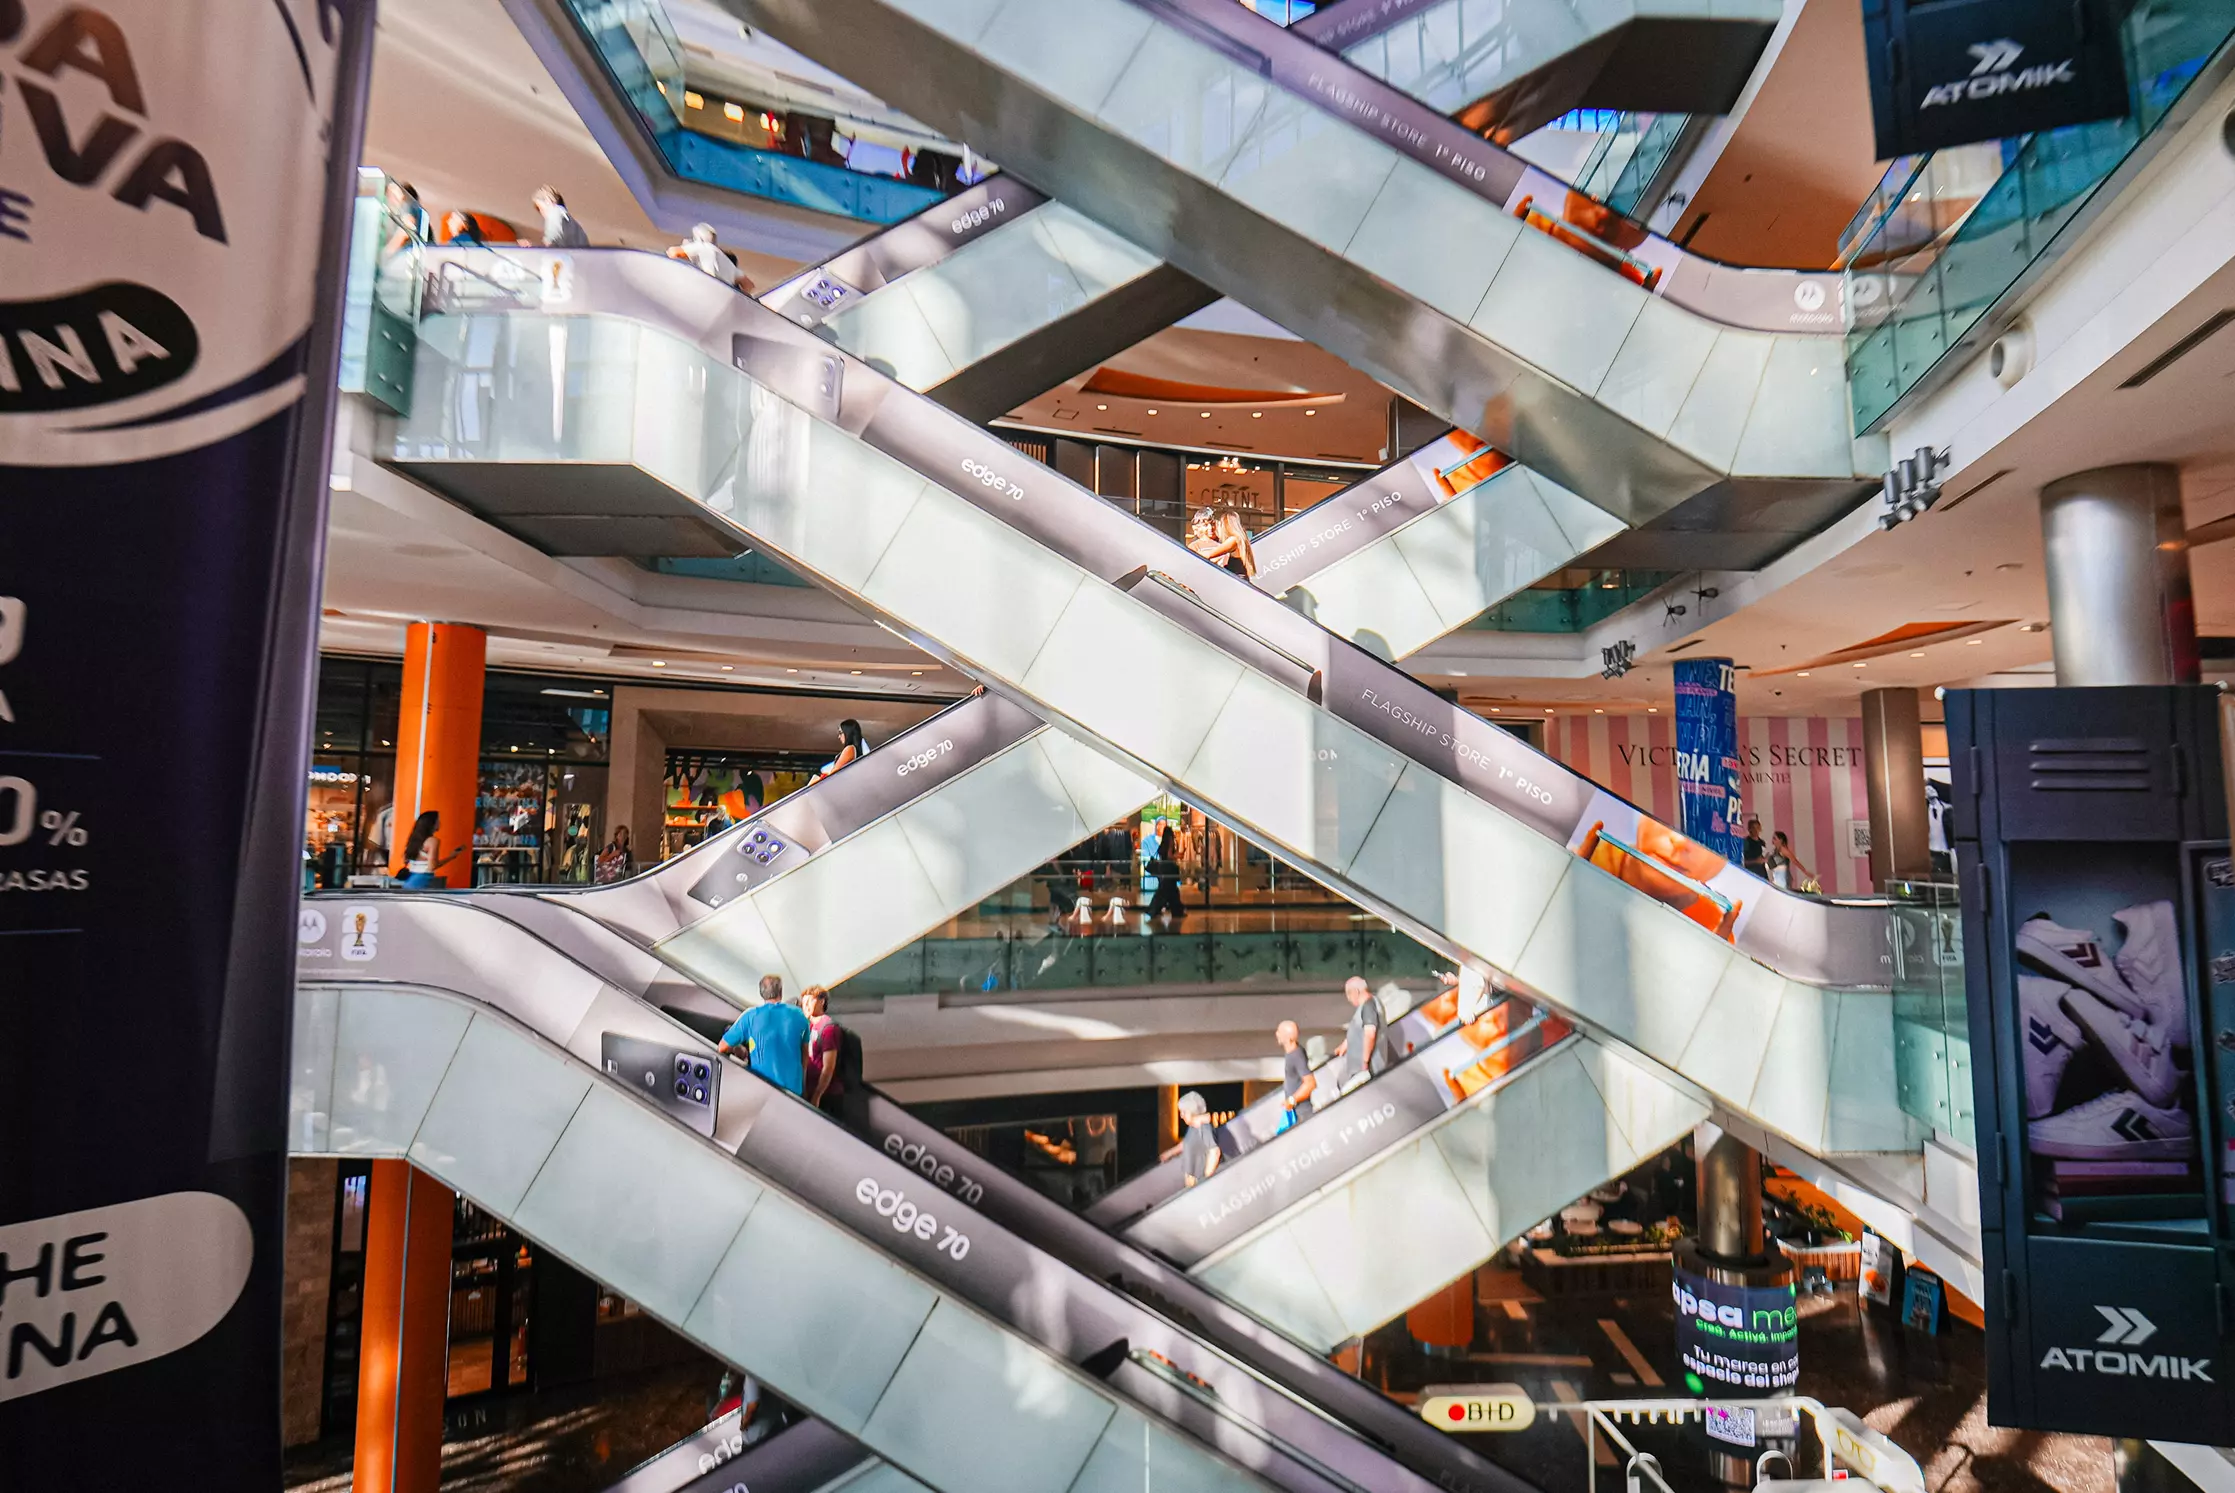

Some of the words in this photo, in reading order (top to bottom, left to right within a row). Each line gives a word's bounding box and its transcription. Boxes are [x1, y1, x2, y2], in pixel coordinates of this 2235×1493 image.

[1920, 58, 2077, 110] ATOMIK
[1380, 112, 1430, 149] STORE
[1451, 152, 1486, 182] PISO
[951, 206, 990, 234] edge
[988, 198, 1005, 215] 70
[961, 459, 1007, 491] edge
[1005, 483, 1024, 501] 70
[1255, 544, 1307, 580] LAGSHIP
[1309, 518, 1352, 549] STORE
[1371, 491, 1402, 514] PISO
[896, 748, 938, 777] edge
[936, 739, 954, 755] 70
[1361, 688, 1437, 737] FLAGSHIP
[1439, 733, 1492, 771] STORE
[1515, 776, 1552, 805] PISO
[1769, 743, 1862, 767] SECRET
[0, 869, 89, 892] ASAS
[1199, 1174, 1275, 1229] FLAGSHIP
[1278, 1140, 1334, 1182] STORE
[1357, 1102, 1397, 1134] PISO
[957, 1175, 983, 1205] 70
[856, 1177, 938, 1241] edge
[936, 1224, 971, 1262] 70
[1682, 1353, 1741, 1385] espacio
[1744, 1373, 1770, 1388] del
[1693, 1343, 1711, 1363] Tu
[2039, 1346, 2216, 1383] ATOMIK
